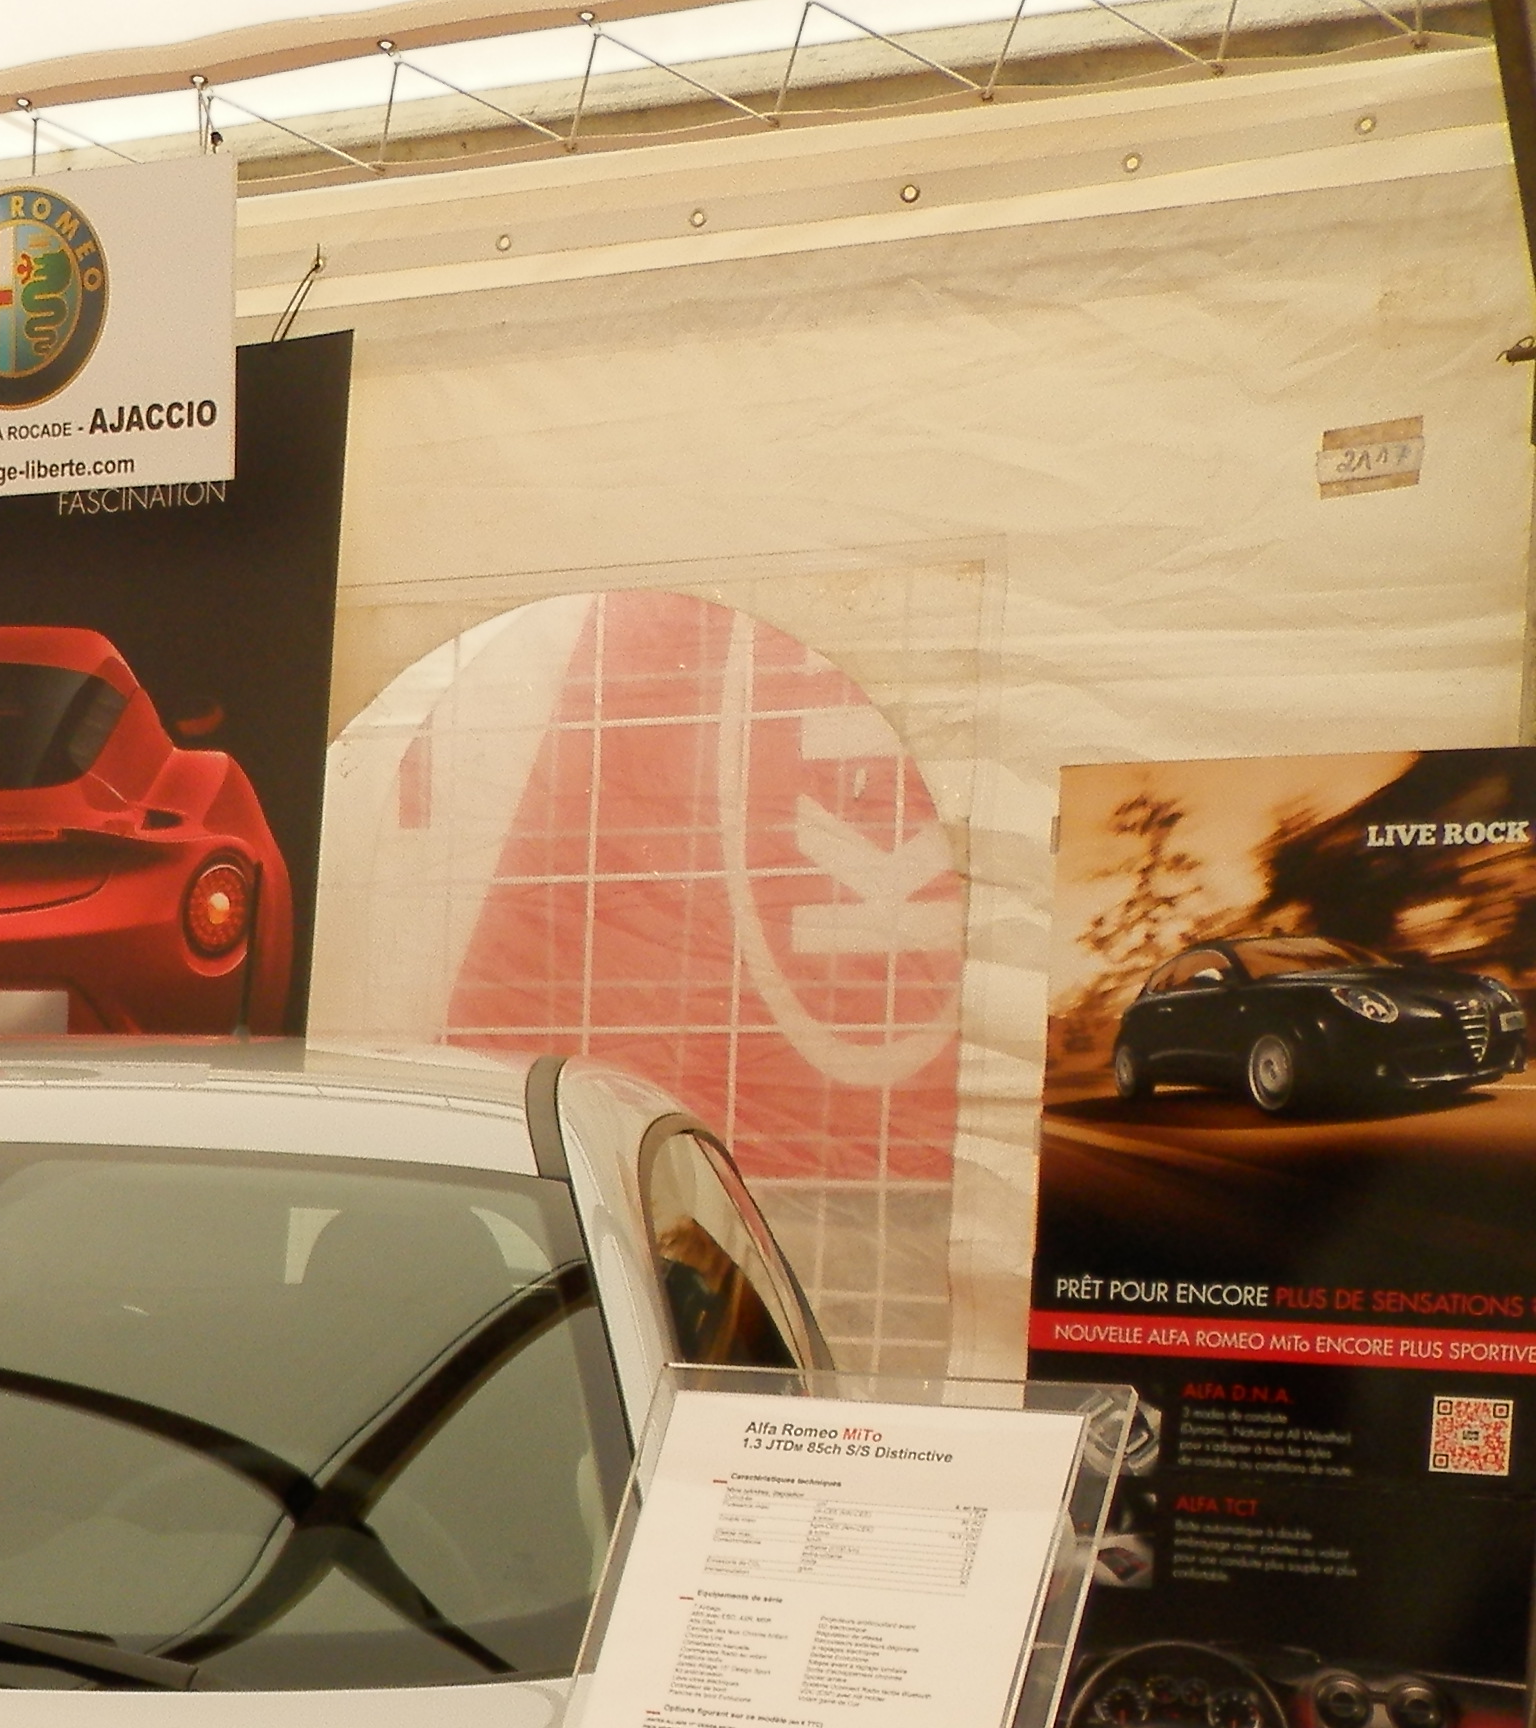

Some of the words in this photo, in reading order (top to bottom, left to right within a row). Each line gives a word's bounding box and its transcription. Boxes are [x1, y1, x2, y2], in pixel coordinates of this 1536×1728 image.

[9, 194, 105, 292] ROMEO
[7, 421, 72, 441] ROCADE
[88, 399, 218, 435] AJACCIO
[57, 481, 227, 516] FASCINATION
[1367, 822, 1437, 848] LIVE
[1443, 821, 1530, 845] ROCK
[1056, 1274, 1103, 1299] PRÊT
[1109, 1280, 1169, 1302] POUR
[1176, 1283, 1269, 1306] ENCORE
[1274, 1286, 1327, 1309] PLUS
[1334, 1288, 1365, 1311] DE
[1371, 1290, 1525, 1318] SENSATIONS
[1055, 1325, 1143, 1344] NOUVELLE
[1147, 1329, 1190, 1346] ALFA
[1195, 1331, 1265, 1350] ROMEO
[1269, 1335, 1310, 1353] MiTo
[1315, 1336, 1394, 1357] ENCORE
[1399, 1340, 1443, 1360] PLUS
[1182, 1383, 1226, 1399] ALFA
[745, 1421, 777, 1436] Alfa
[781, 1423, 839, 1440] Romeo
[842, 1427, 883, 1443] MiTo
[742, 1437, 762, 1450] 1.3
[806, 1442, 842, 1456] 85ch
[845, 1444, 871, 1458] S/S
[874, 1447, 953, 1464] Distinctive
